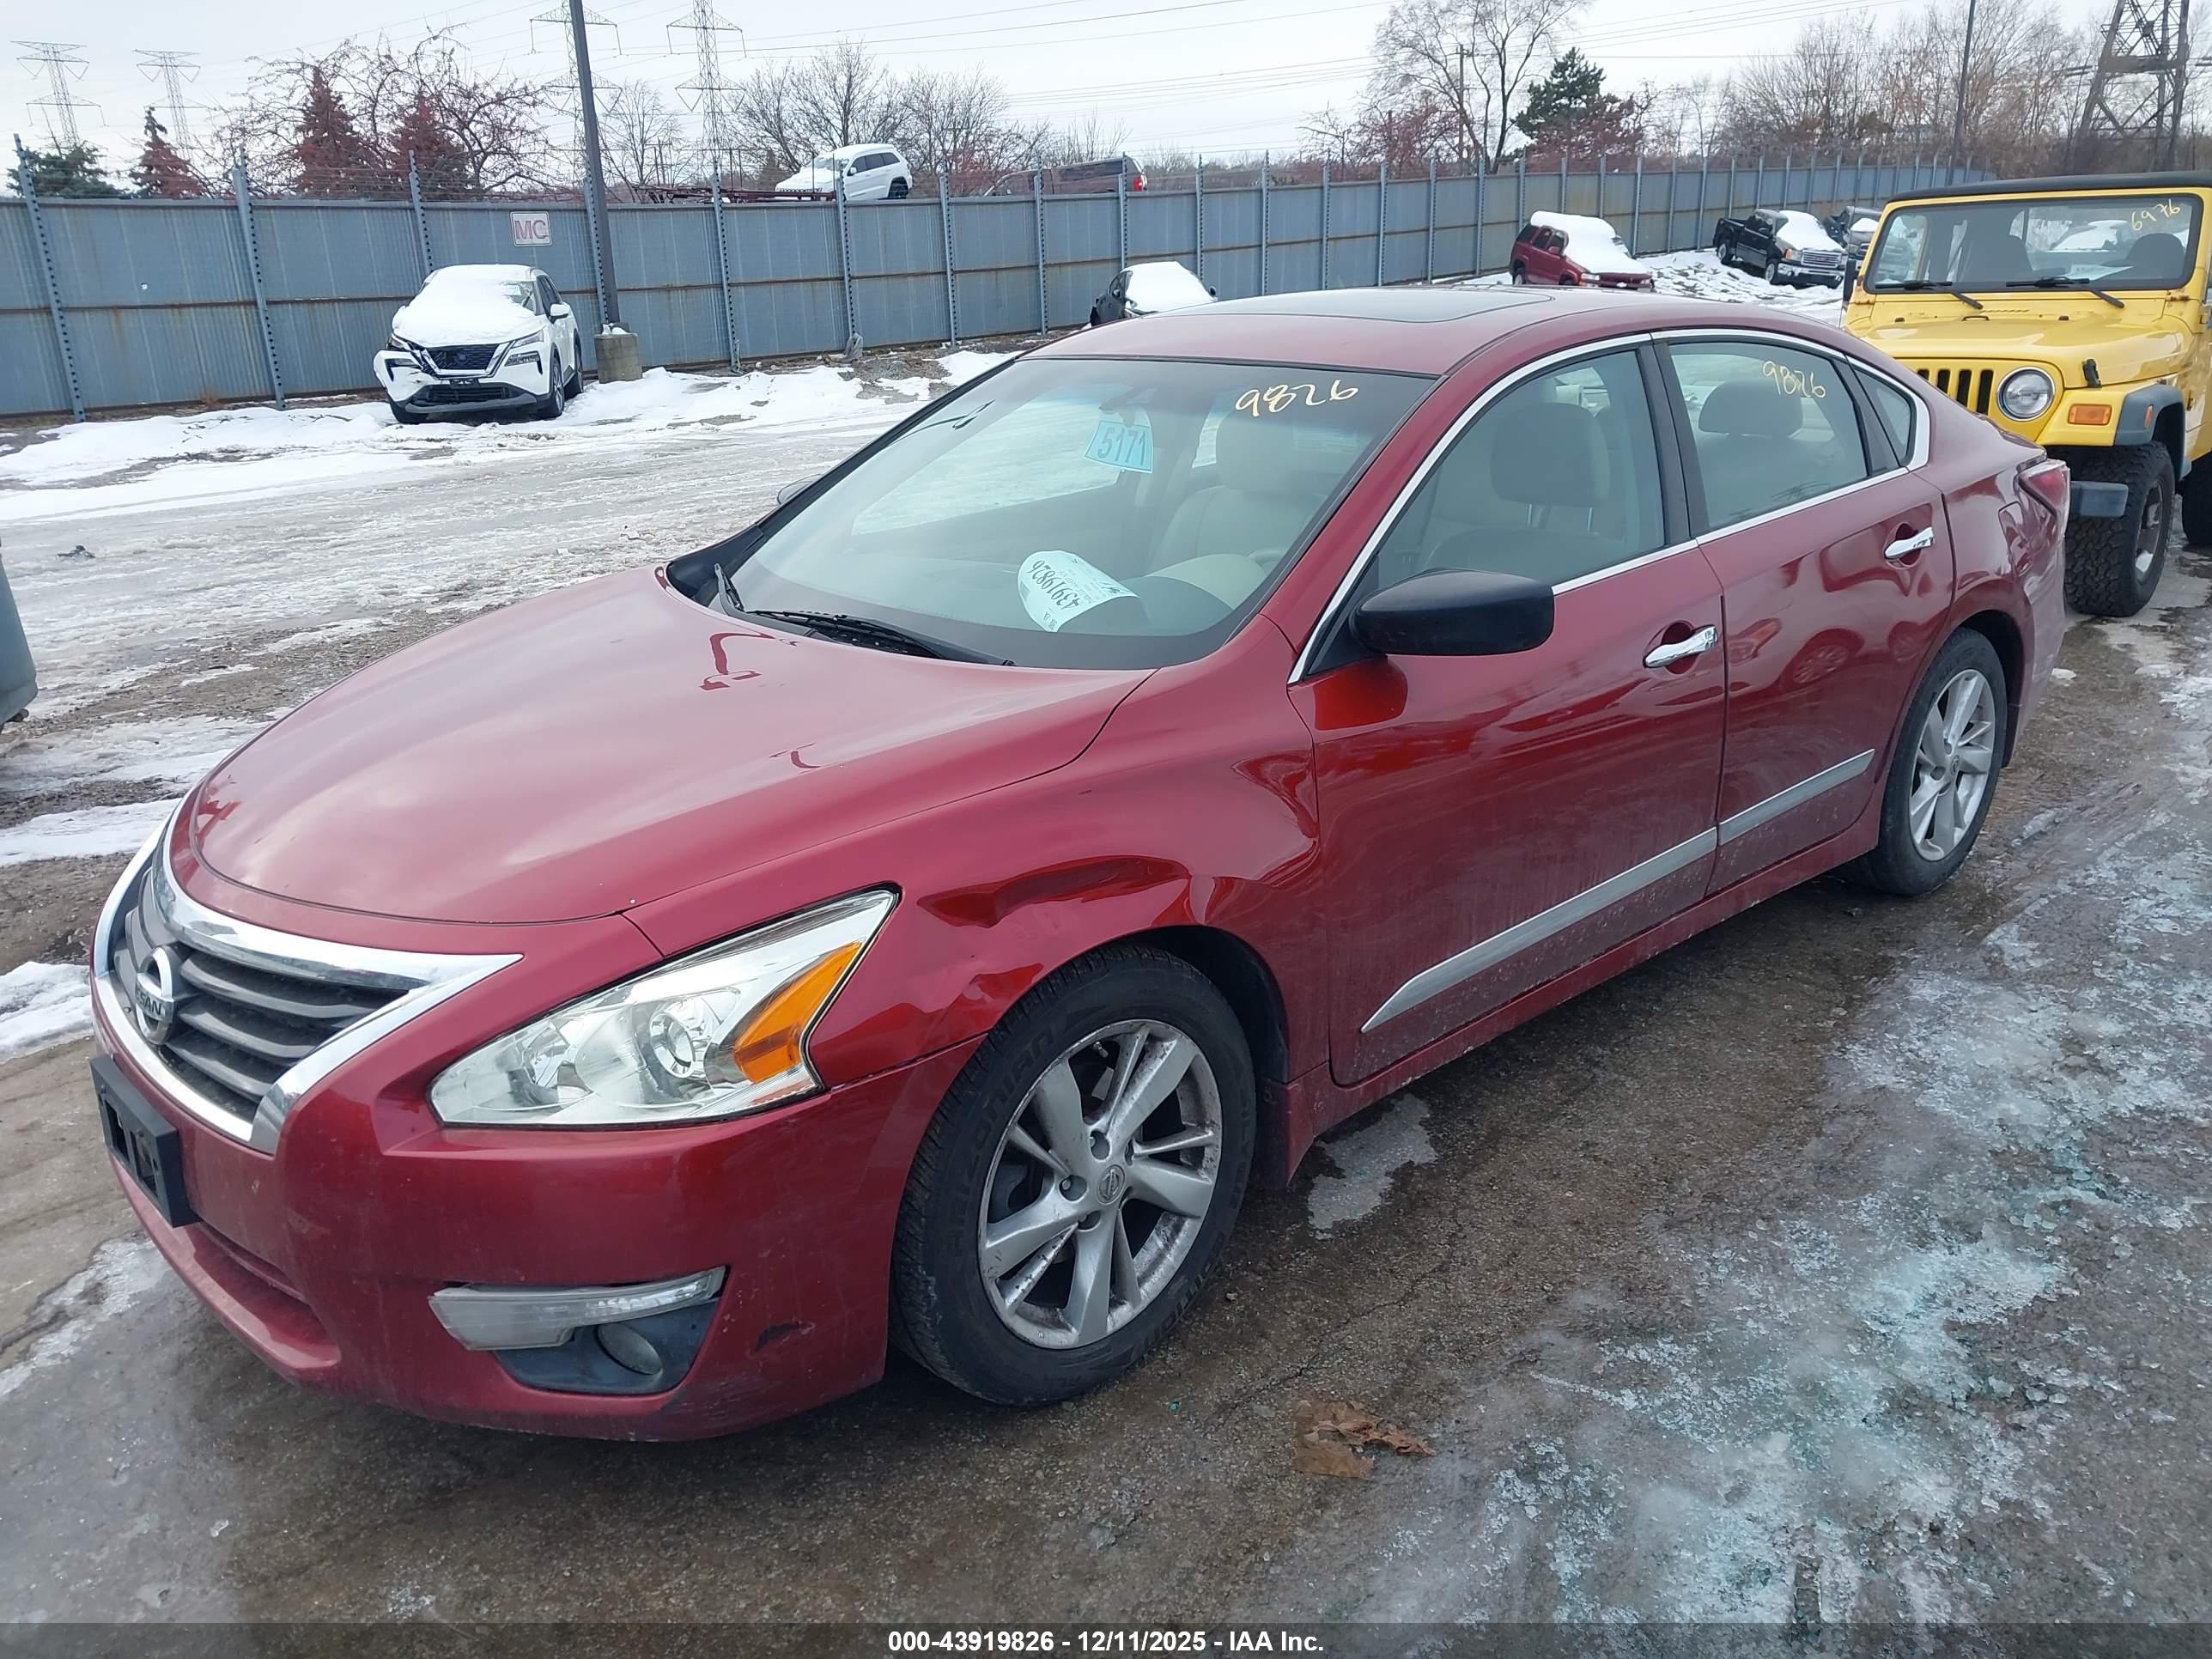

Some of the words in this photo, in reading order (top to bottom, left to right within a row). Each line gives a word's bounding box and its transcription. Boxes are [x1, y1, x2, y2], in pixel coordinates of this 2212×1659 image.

[2131, 198, 2181, 231] 6976
[1762, 361, 1826, 398] 9826
[1235, 380, 1358, 417] 9826
[1097, 427, 1146, 466] 5171
[1026, 560, 1079, 611] 43919826
